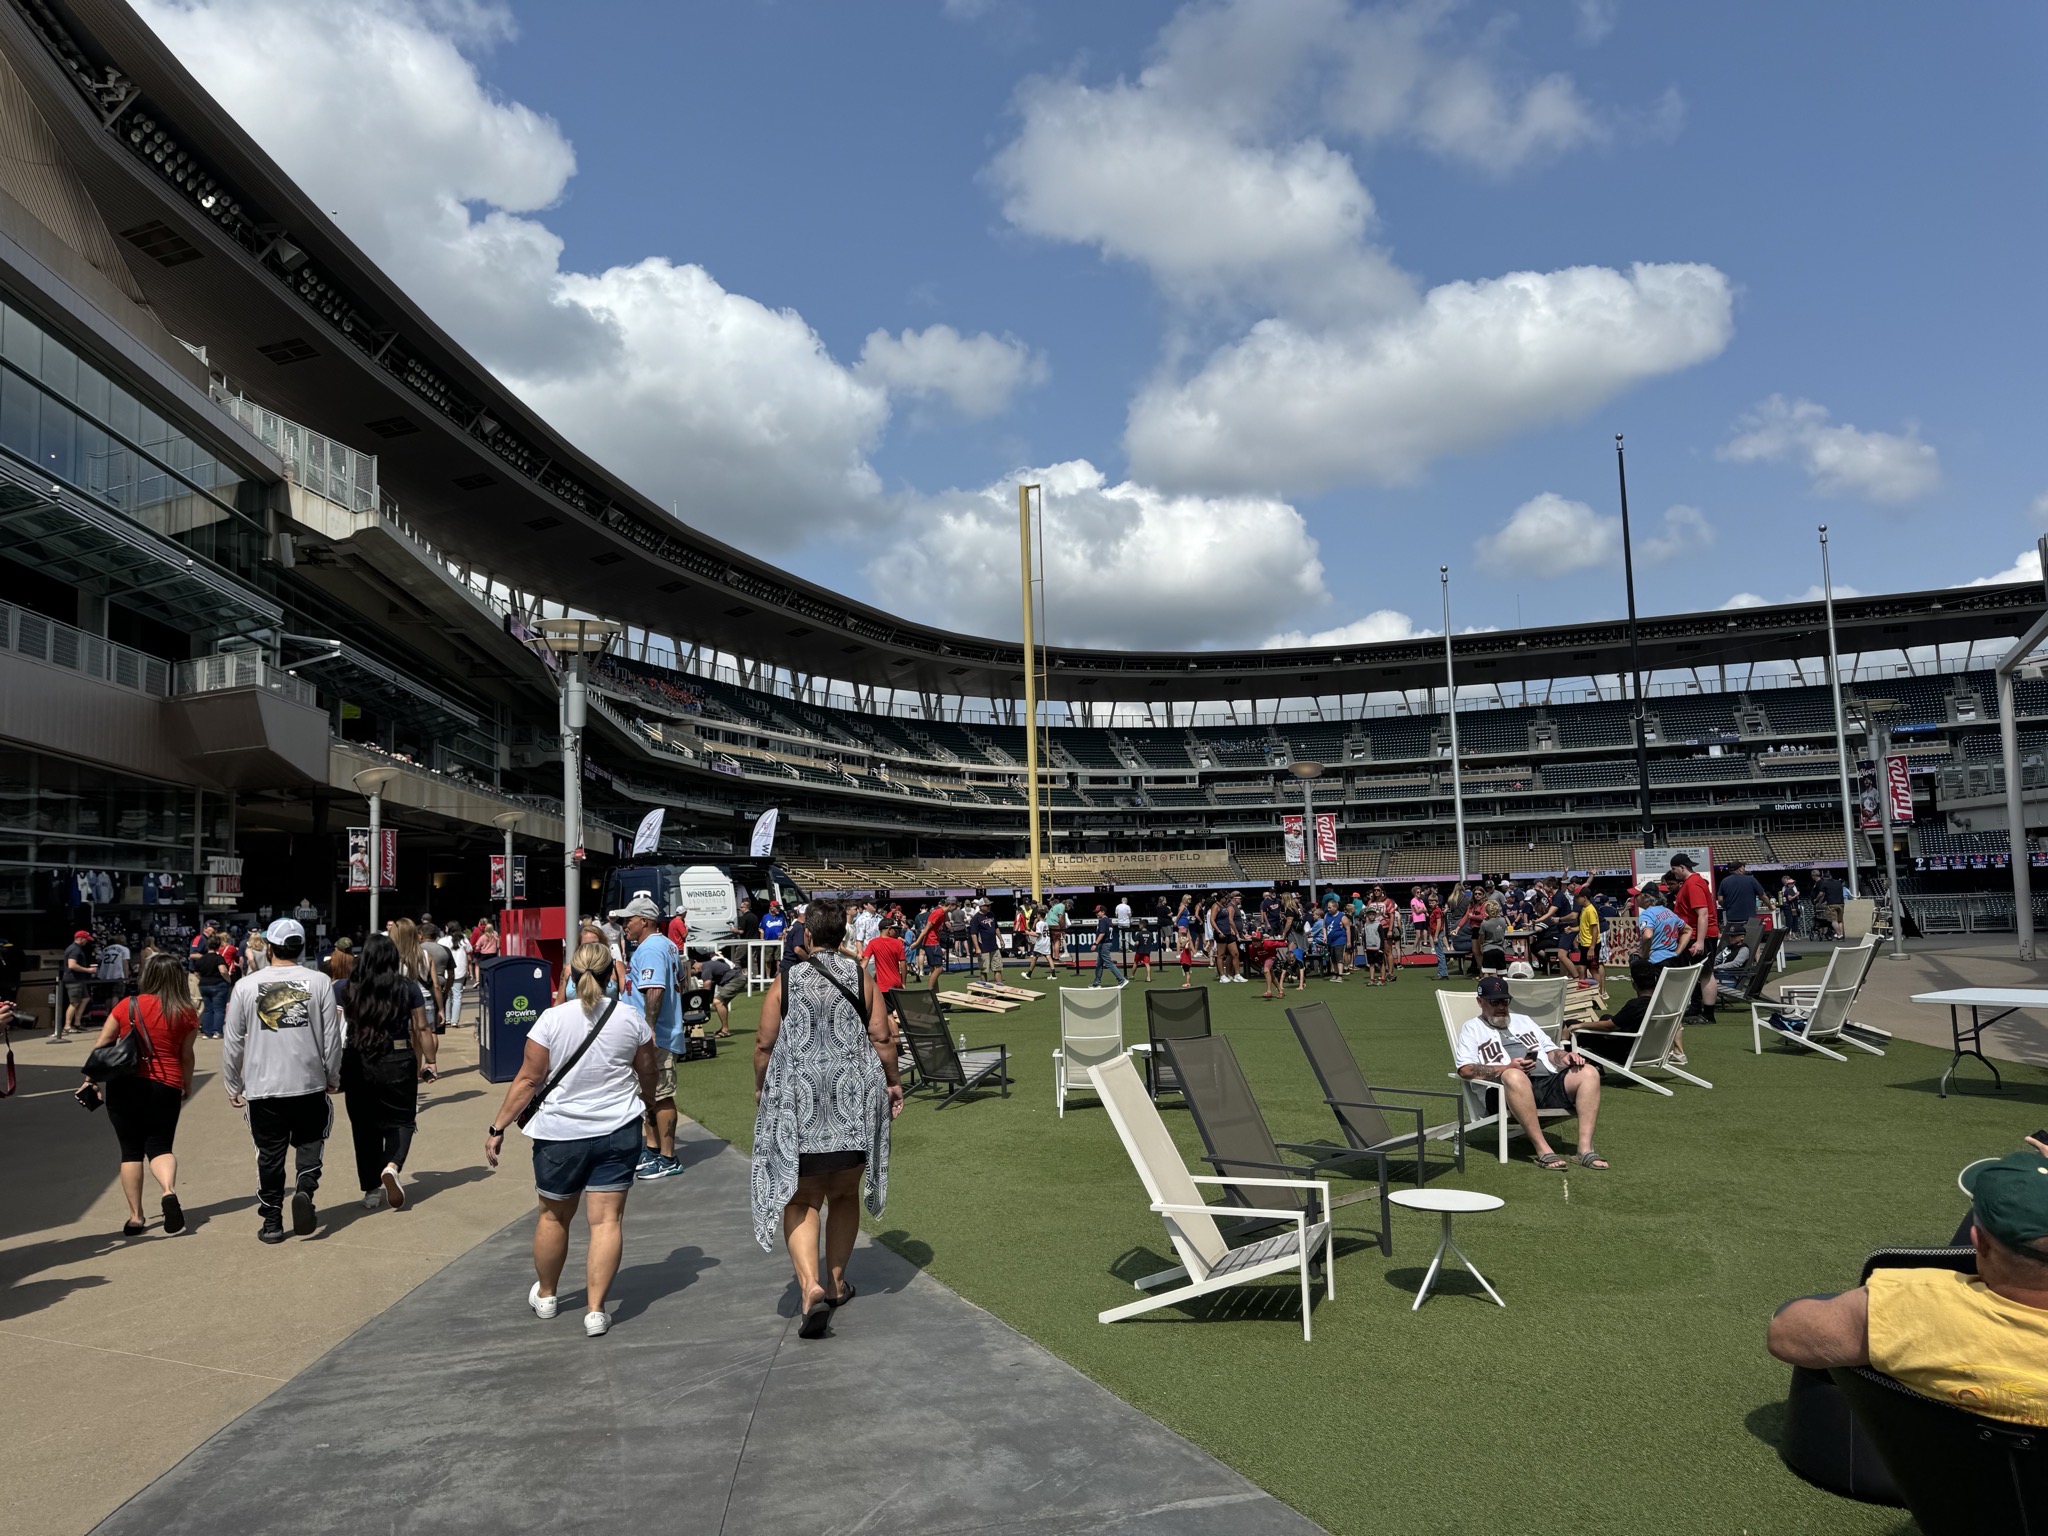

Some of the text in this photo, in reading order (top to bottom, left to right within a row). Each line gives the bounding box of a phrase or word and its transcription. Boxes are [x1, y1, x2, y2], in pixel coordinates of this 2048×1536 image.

[1889, 759, 1913, 820] Twins
[1774, 803, 1802, 811] thrivent
[1318, 816, 1337, 861] Twins
[1101, 855, 1115, 863] TO
[1117, 854, 1158, 863] TARGET
[1169, 853, 1200, 861] FIELD
[207, 856, 244, 876] TRULY
[686, 889, 726, 898] WINNEBAGO
[103, 953, 119, 965] 27
